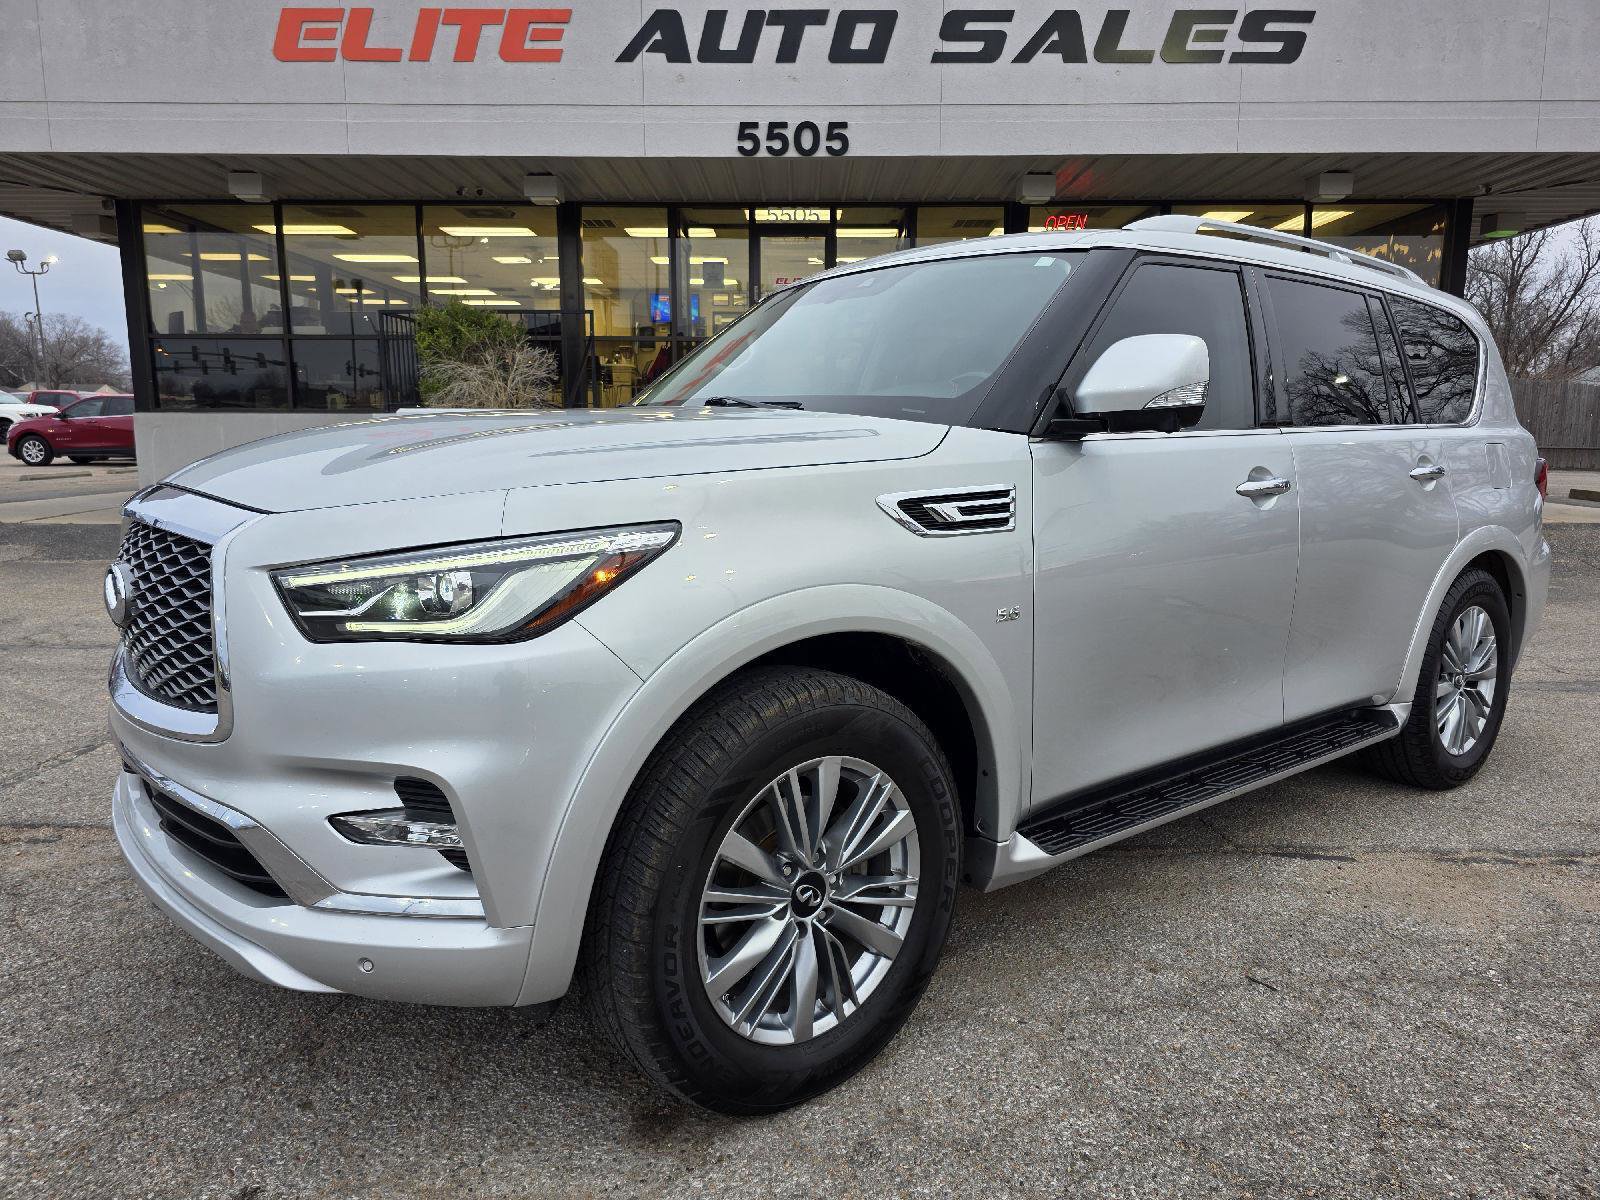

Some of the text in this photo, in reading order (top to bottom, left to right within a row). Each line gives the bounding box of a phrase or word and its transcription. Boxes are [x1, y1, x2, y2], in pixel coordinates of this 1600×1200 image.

[272, 7, 1317, 65] ELITE AUTO SALES
[737, 121, 850, 157] 5505
[766, 207, 819, 223] 5505
[1045, 214, 1088, 231] OPEN
[919, 758, 957, 911] COOPER
